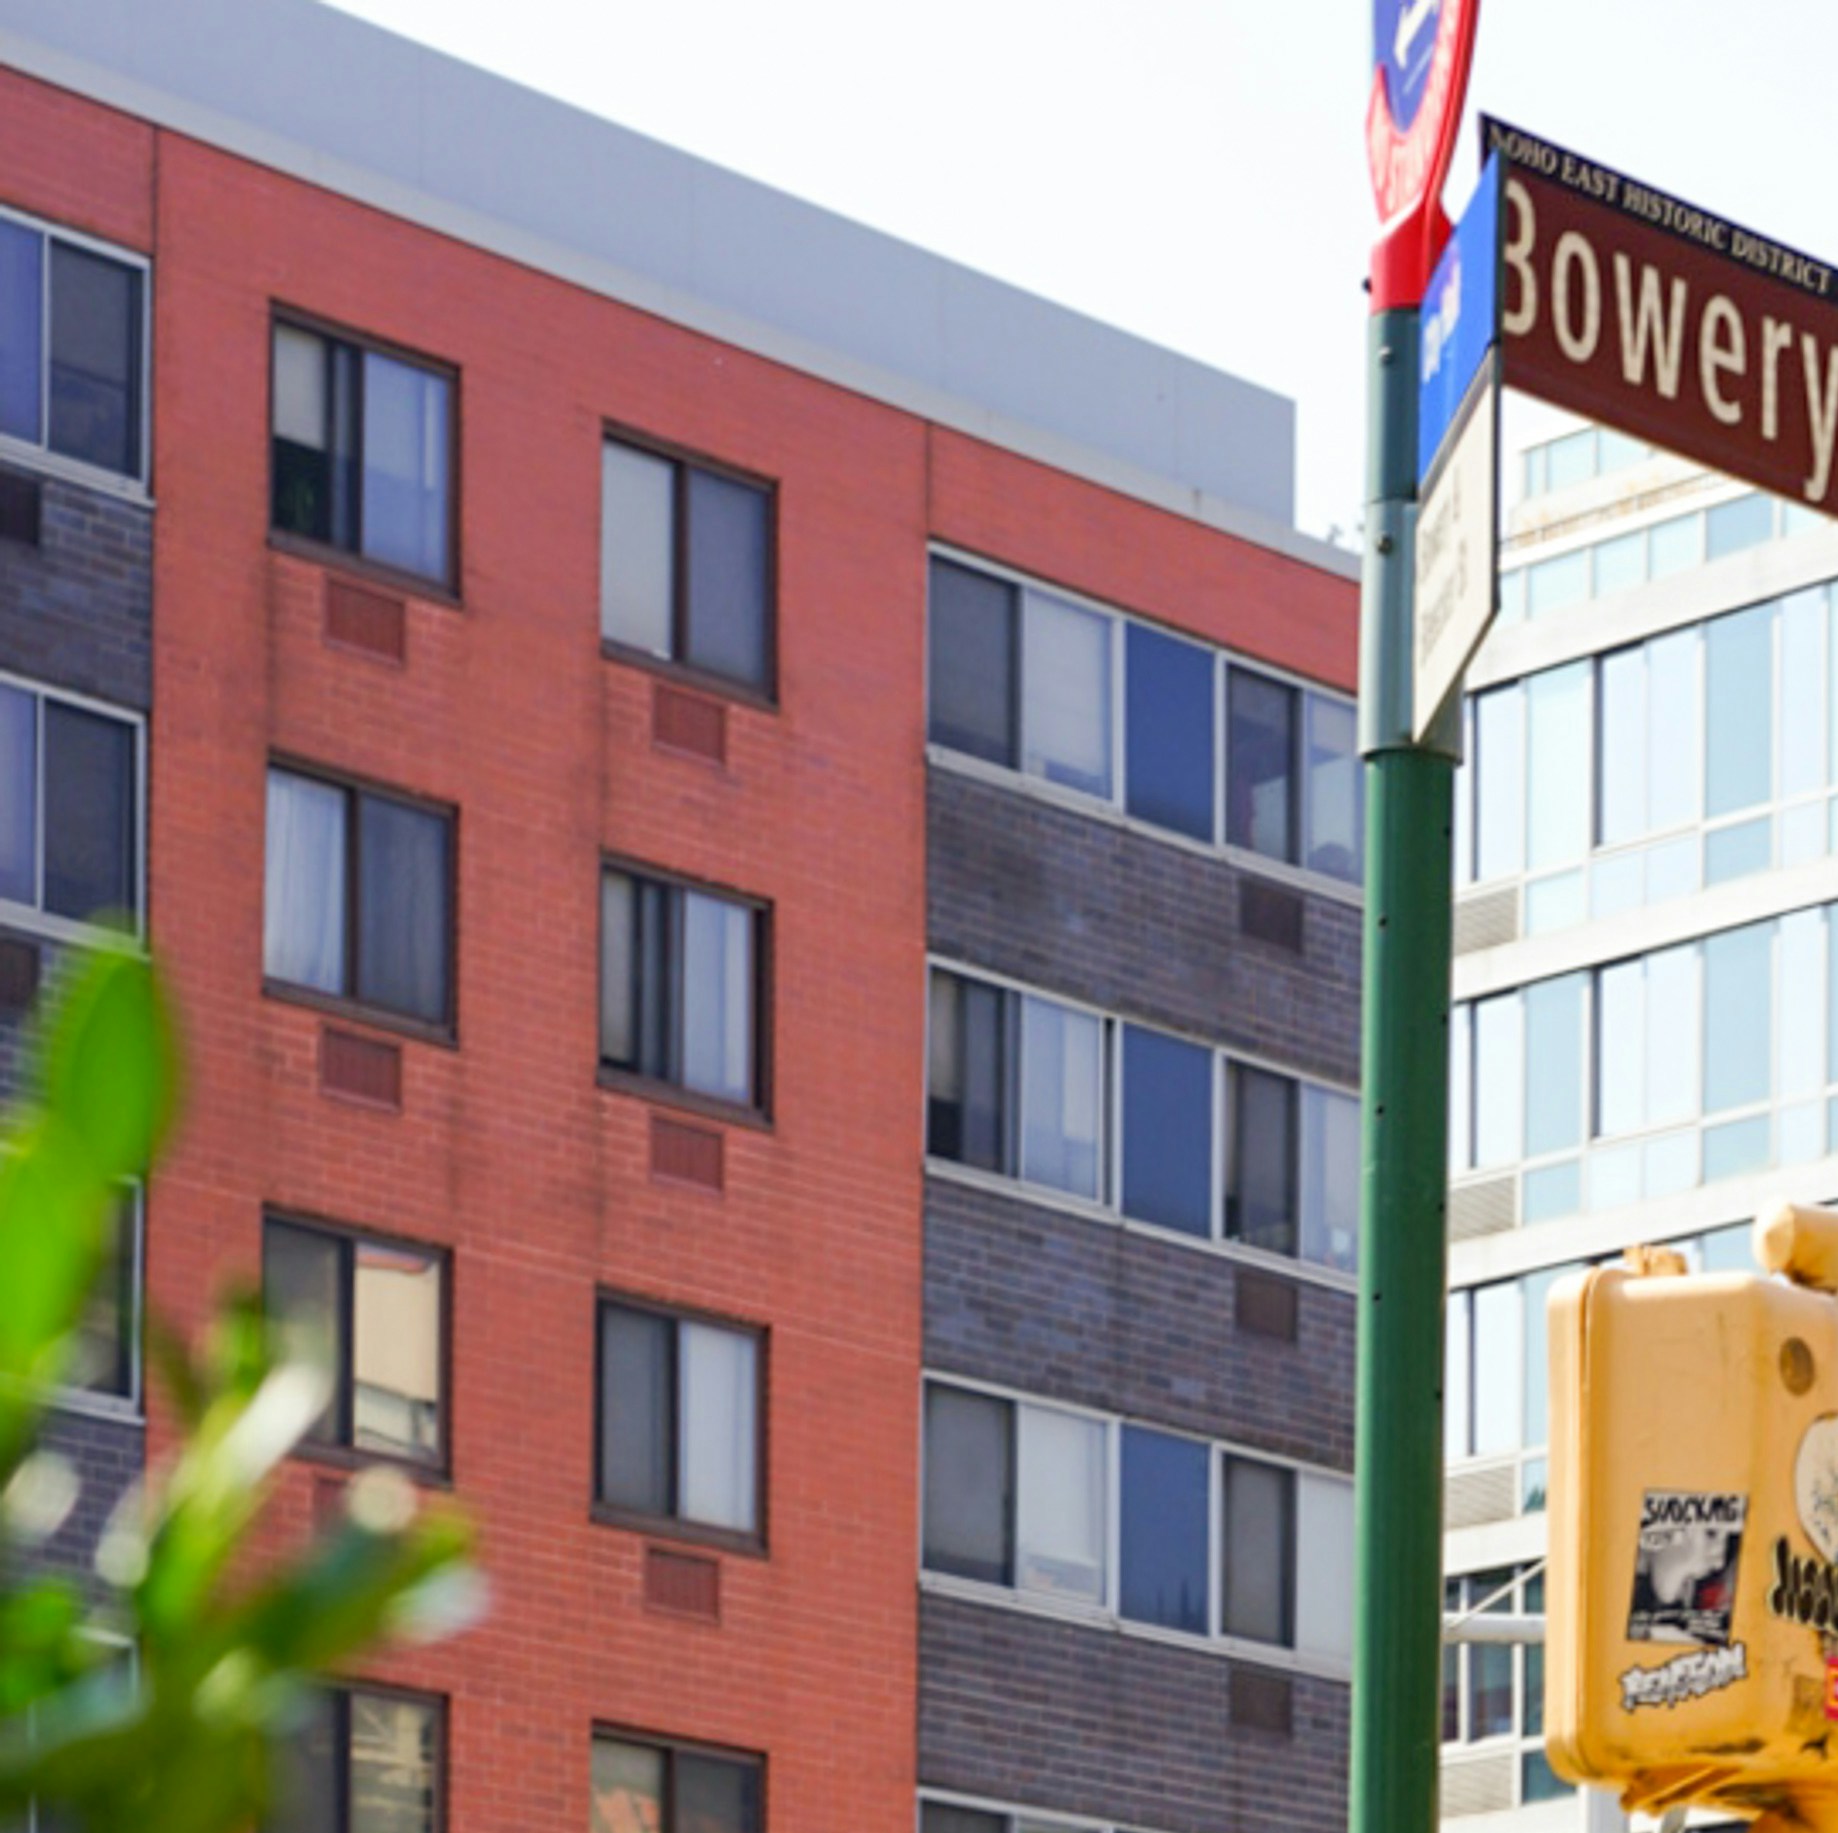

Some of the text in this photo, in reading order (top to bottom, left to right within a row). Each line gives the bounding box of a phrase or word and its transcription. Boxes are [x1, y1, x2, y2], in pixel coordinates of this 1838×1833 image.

[1561, 152, 1623, 202] EAST
[1621, 183, 1729, 250] HISTORIC
[1730, 223, 1833, 296] DISTRICT
